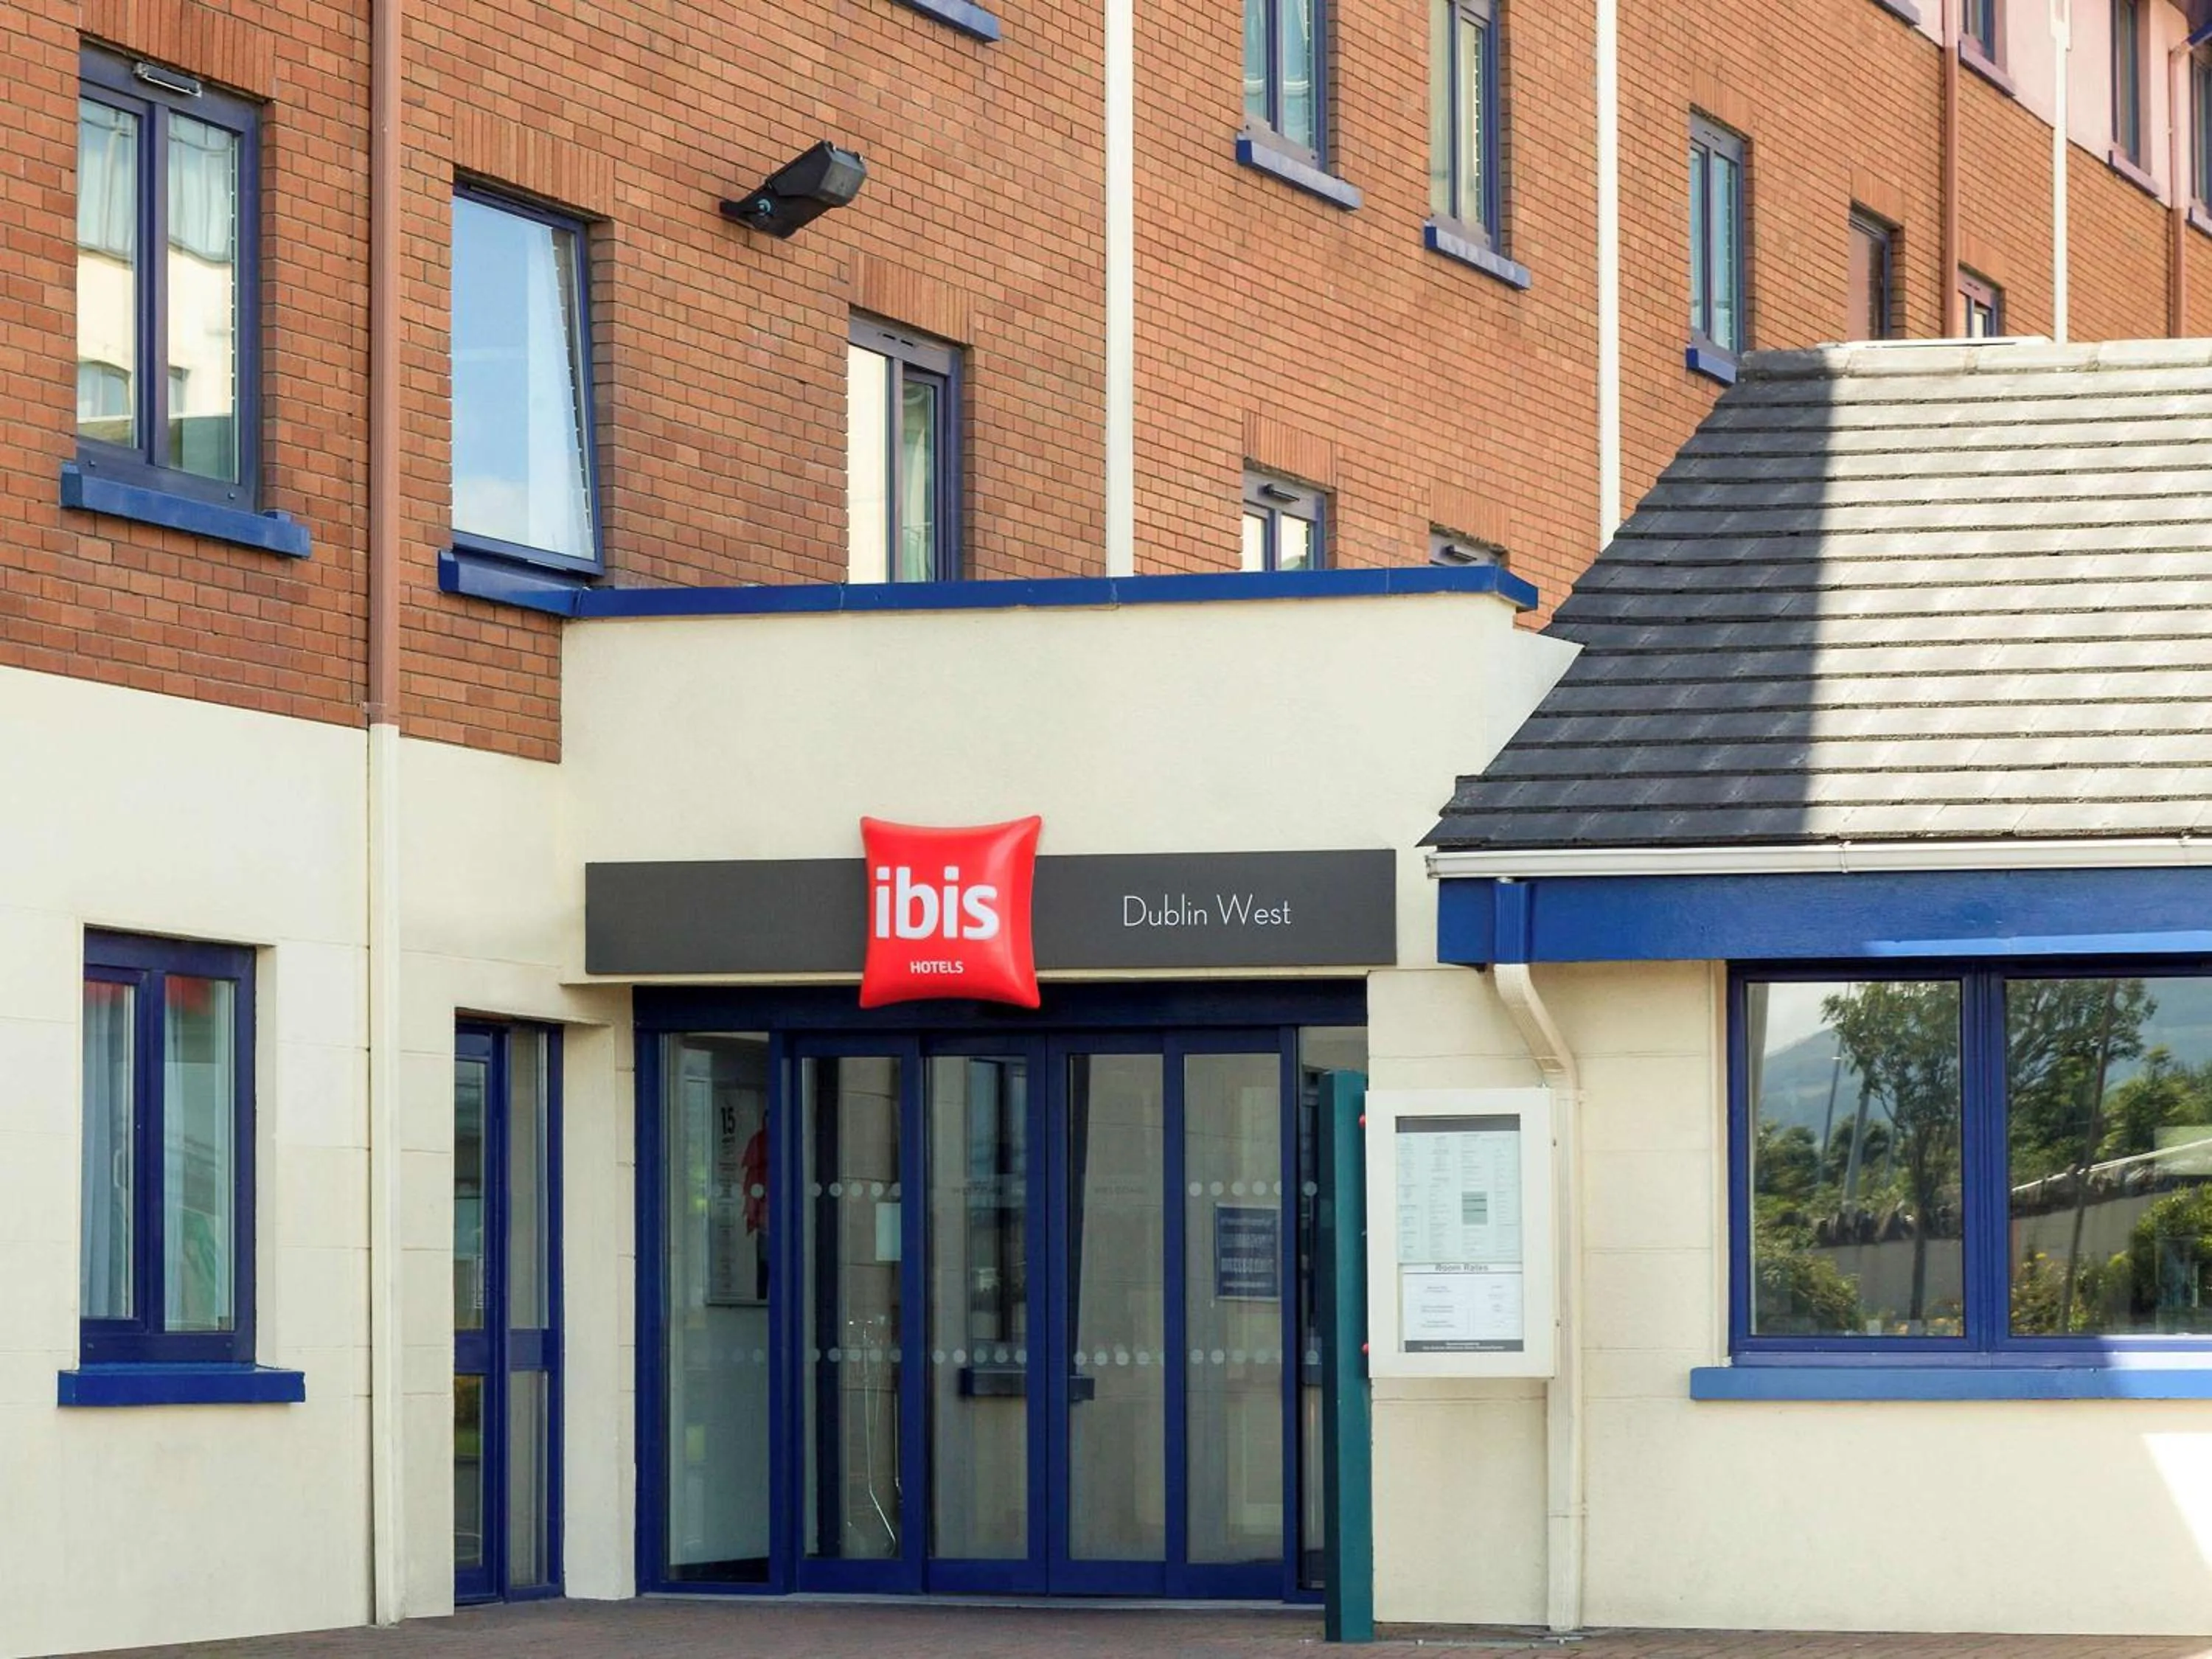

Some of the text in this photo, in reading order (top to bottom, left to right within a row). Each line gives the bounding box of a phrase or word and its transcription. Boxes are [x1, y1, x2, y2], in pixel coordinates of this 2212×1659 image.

[876, 866, 1001, 940] ibis
[1123, 893, 1292, 927] Dublin West
[910, 960, 964, 974] HOTELS
